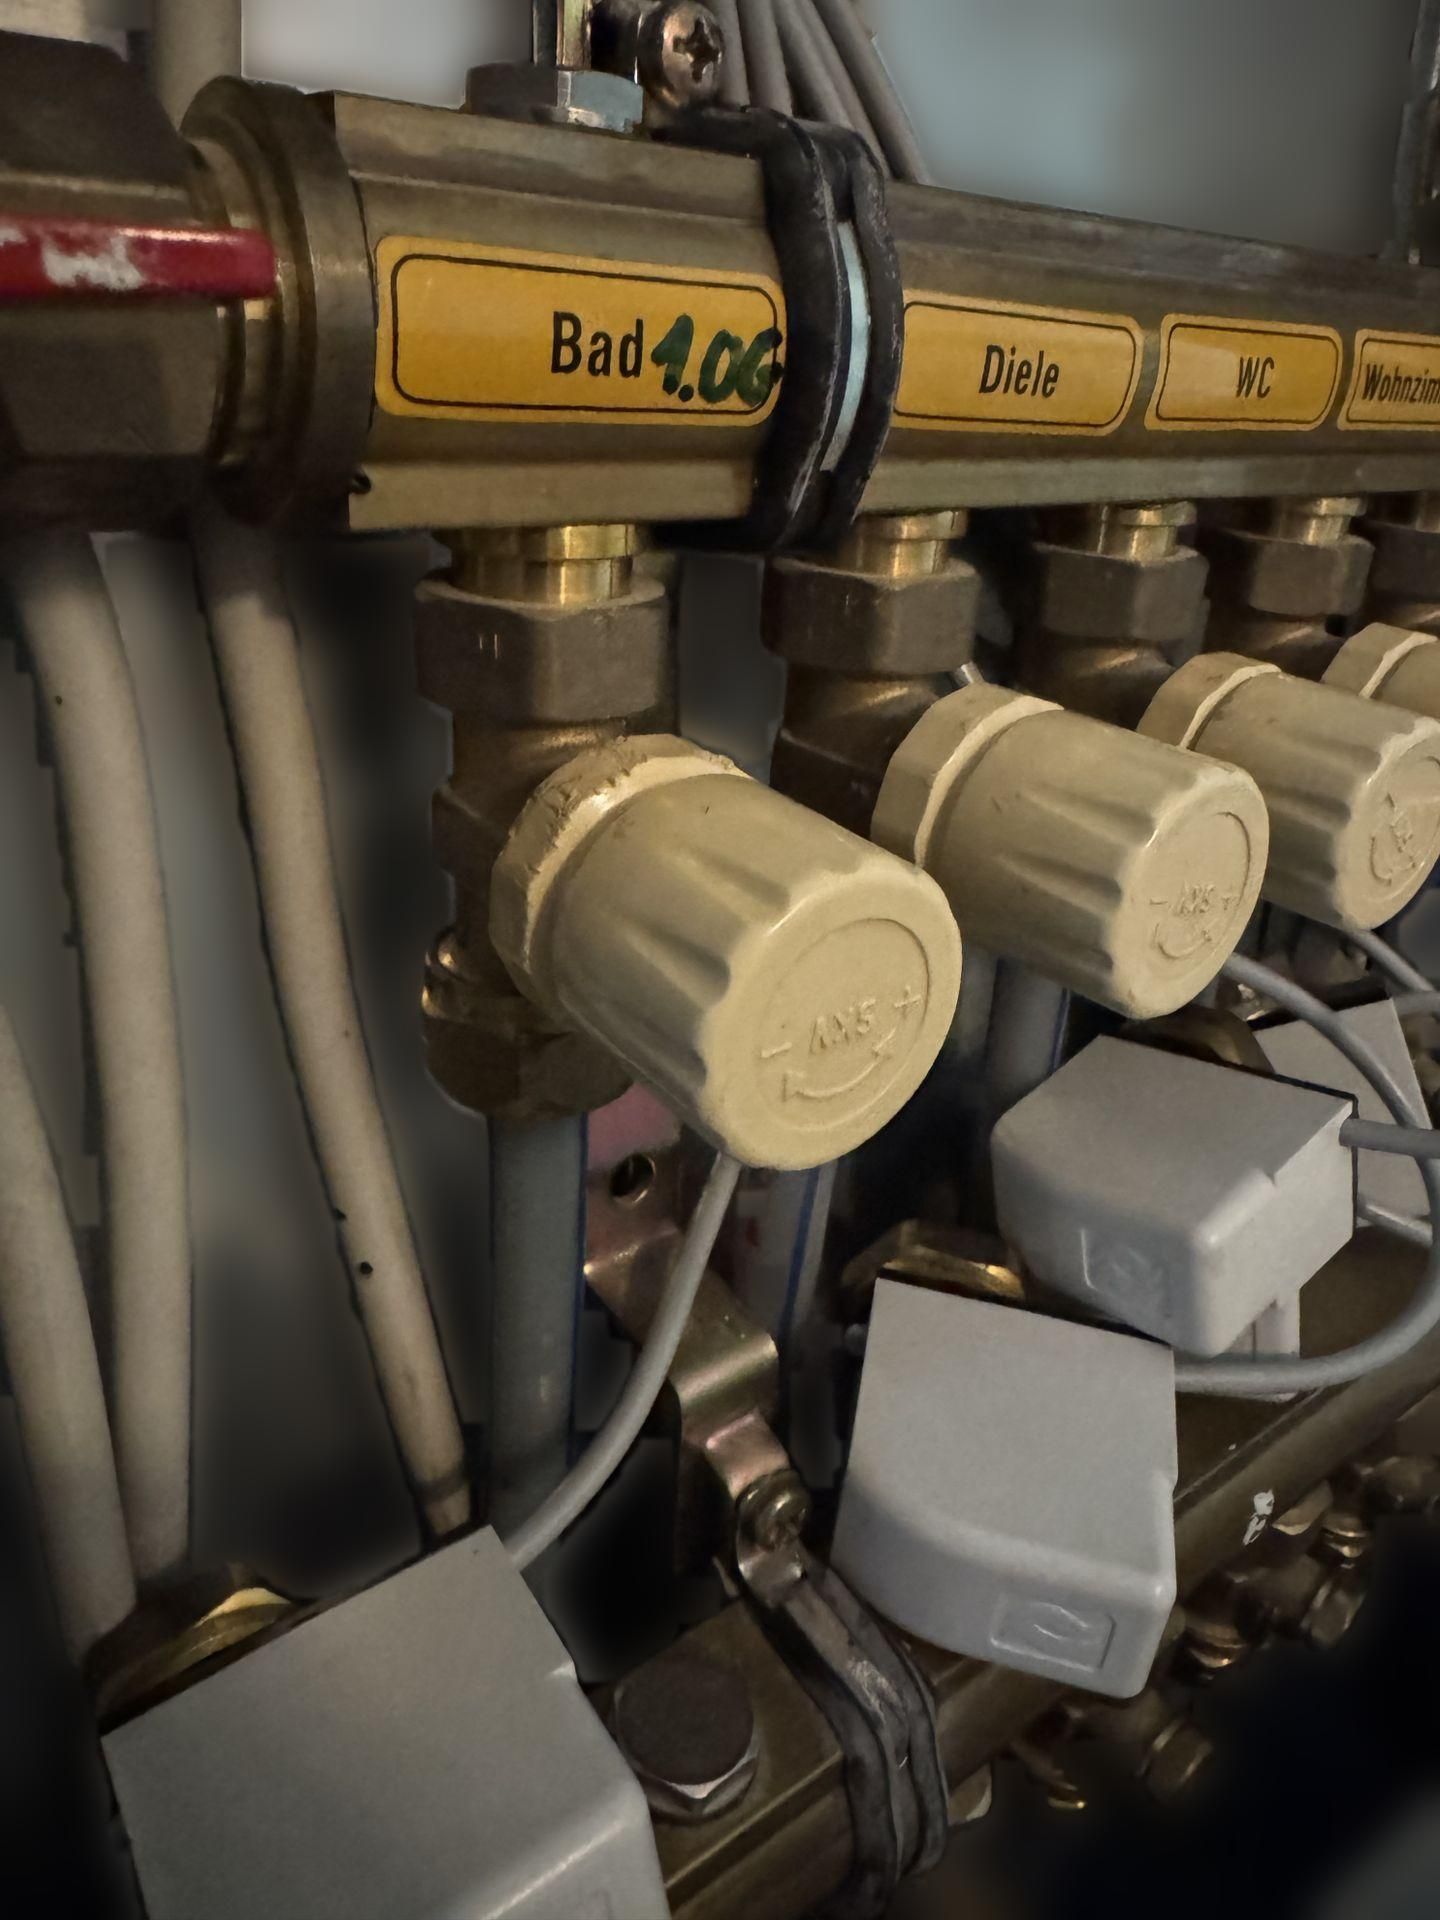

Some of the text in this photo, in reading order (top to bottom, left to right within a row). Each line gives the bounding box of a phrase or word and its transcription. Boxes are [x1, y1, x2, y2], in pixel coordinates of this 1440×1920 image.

[551, 311, 644, 378] Bad
[978, 344, 1060, 399] Diele
[1234, 356, 1275, 399] WC
